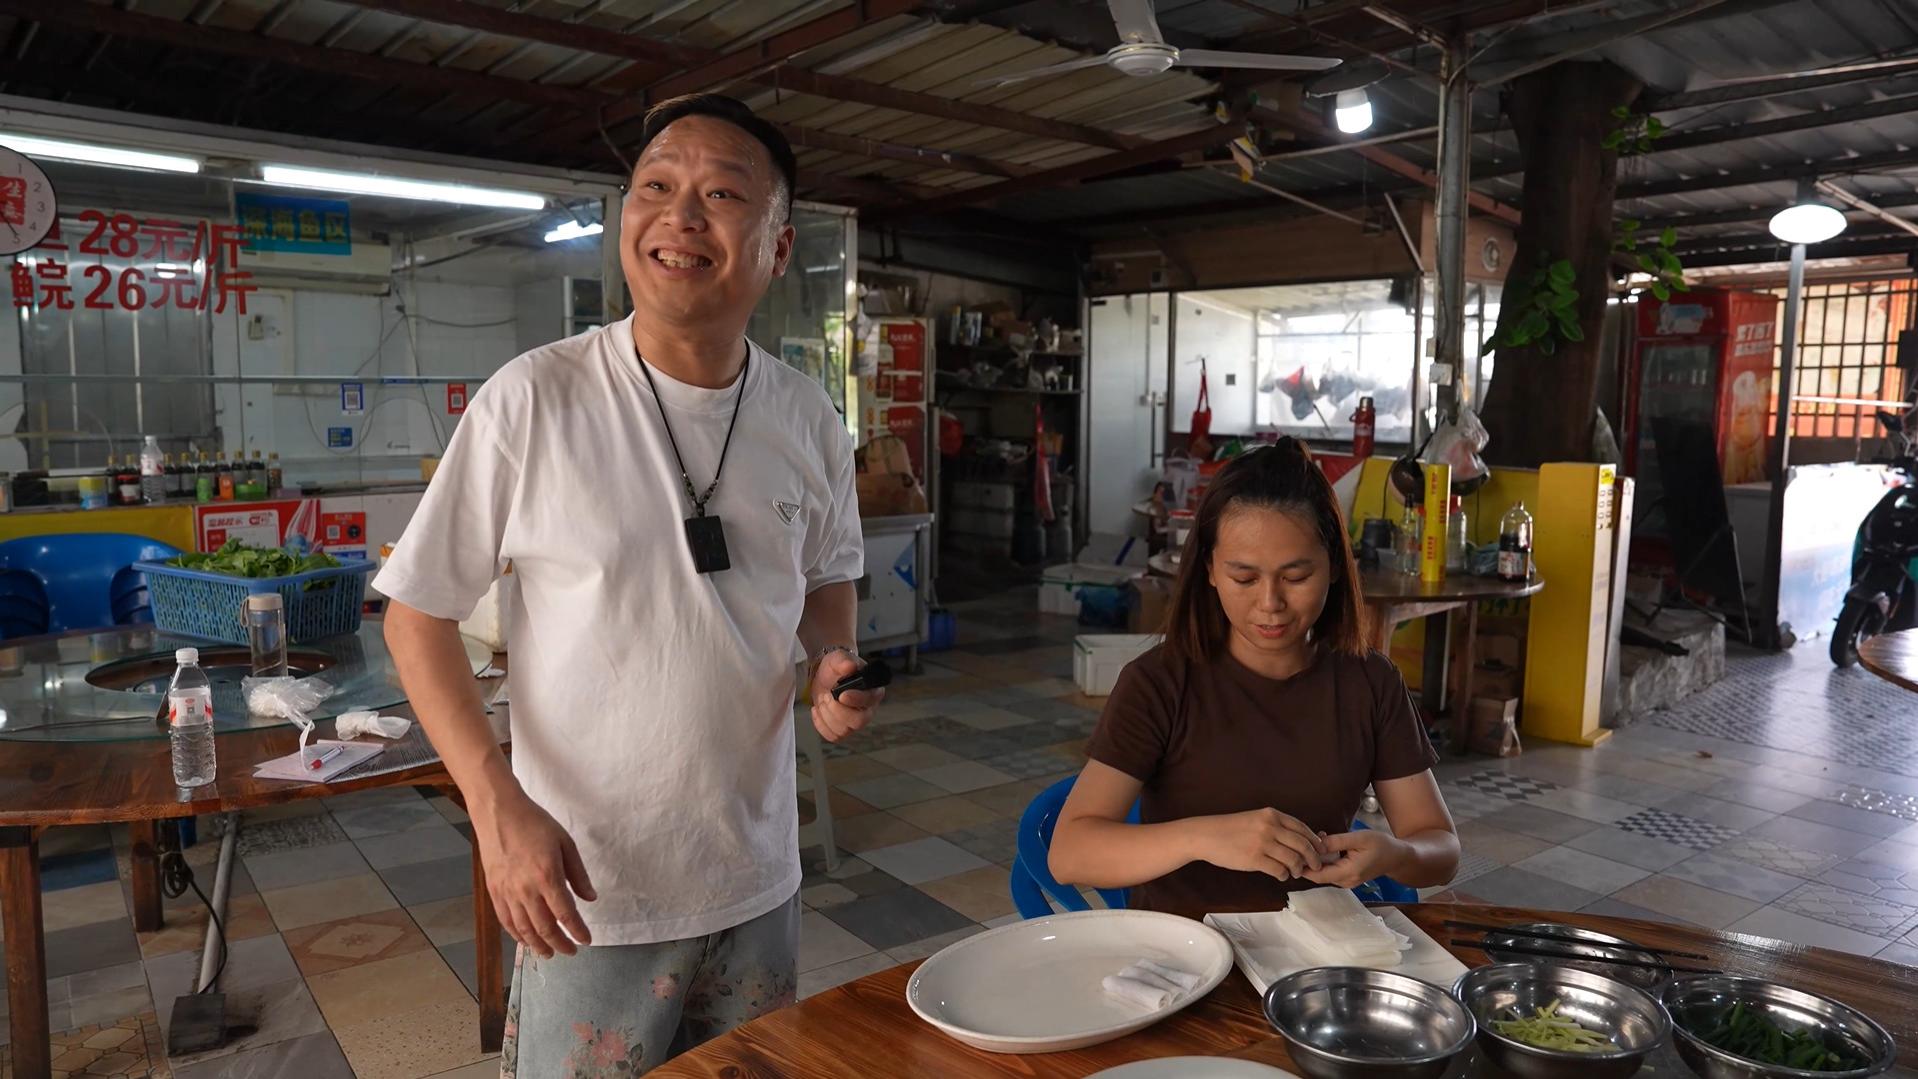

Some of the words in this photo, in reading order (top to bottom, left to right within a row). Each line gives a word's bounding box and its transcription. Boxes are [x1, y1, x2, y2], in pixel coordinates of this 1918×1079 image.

[33, 182, 42, 193] 2
[37, 201, 46, 213] 3
[29, 221, 36, 231] 4
